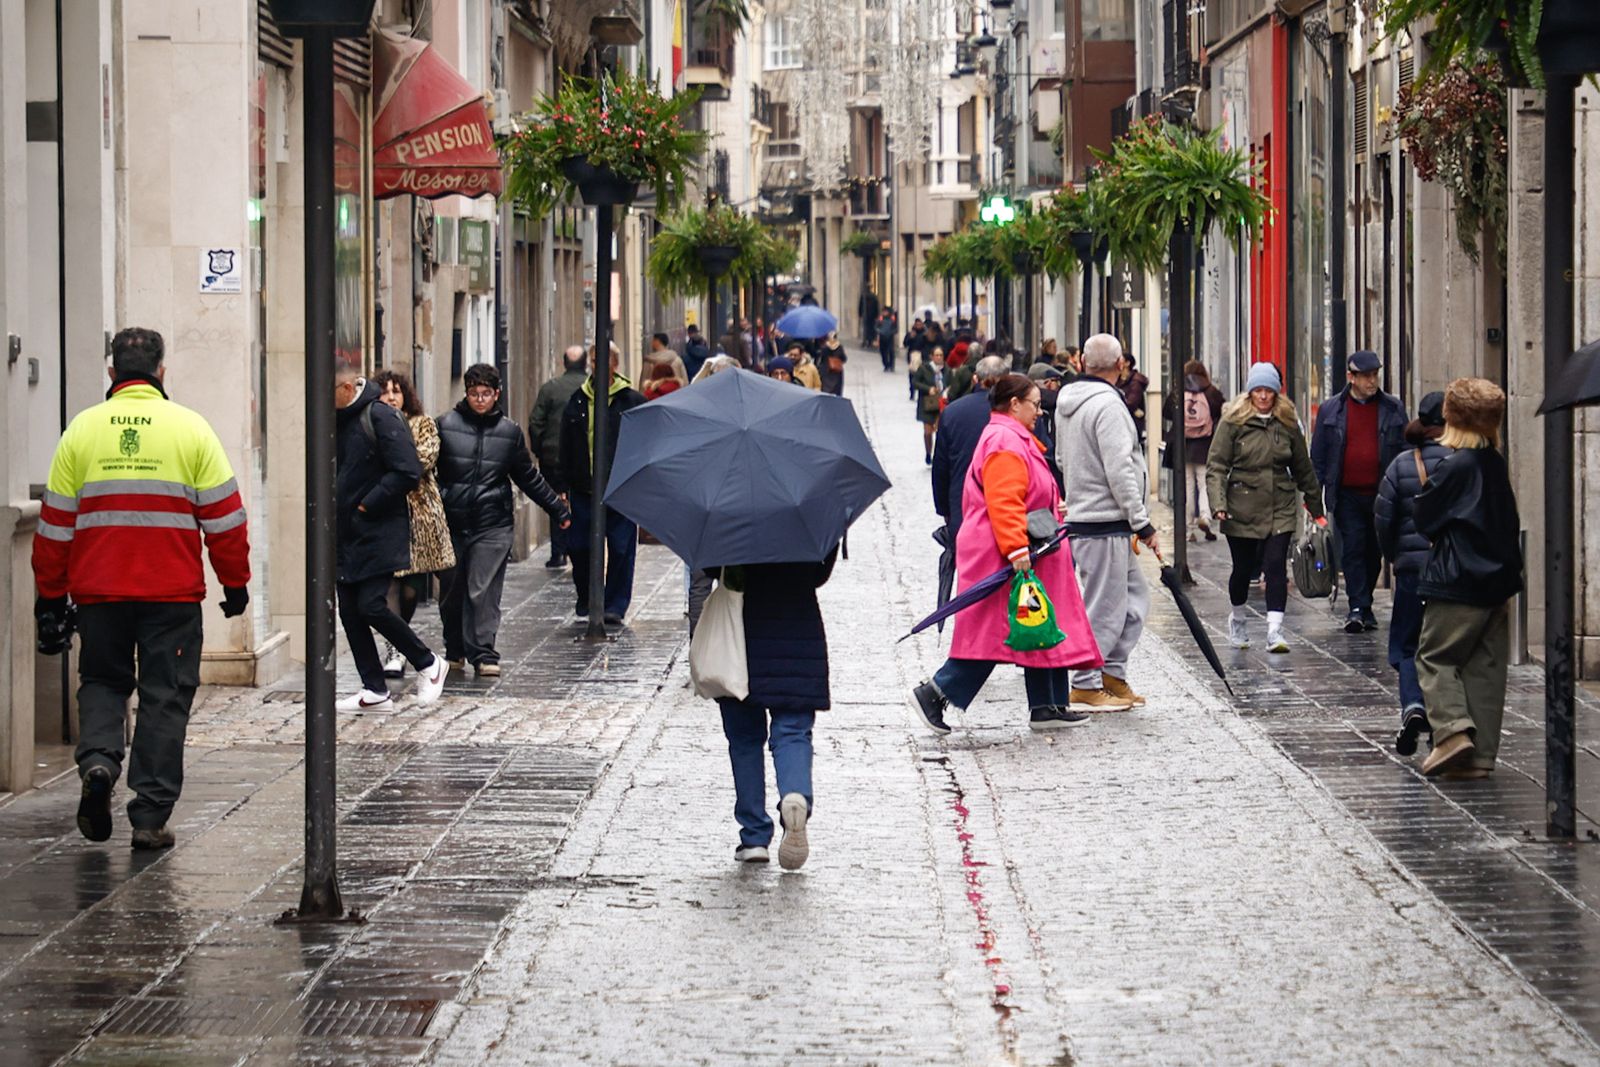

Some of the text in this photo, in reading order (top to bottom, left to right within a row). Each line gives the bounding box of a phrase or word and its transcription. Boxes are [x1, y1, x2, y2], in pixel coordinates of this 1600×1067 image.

[395, 123, 483, 164] PENSION
[383, 169, 490, 190] Mesones
[110, 416, 152, 425] EULEN
